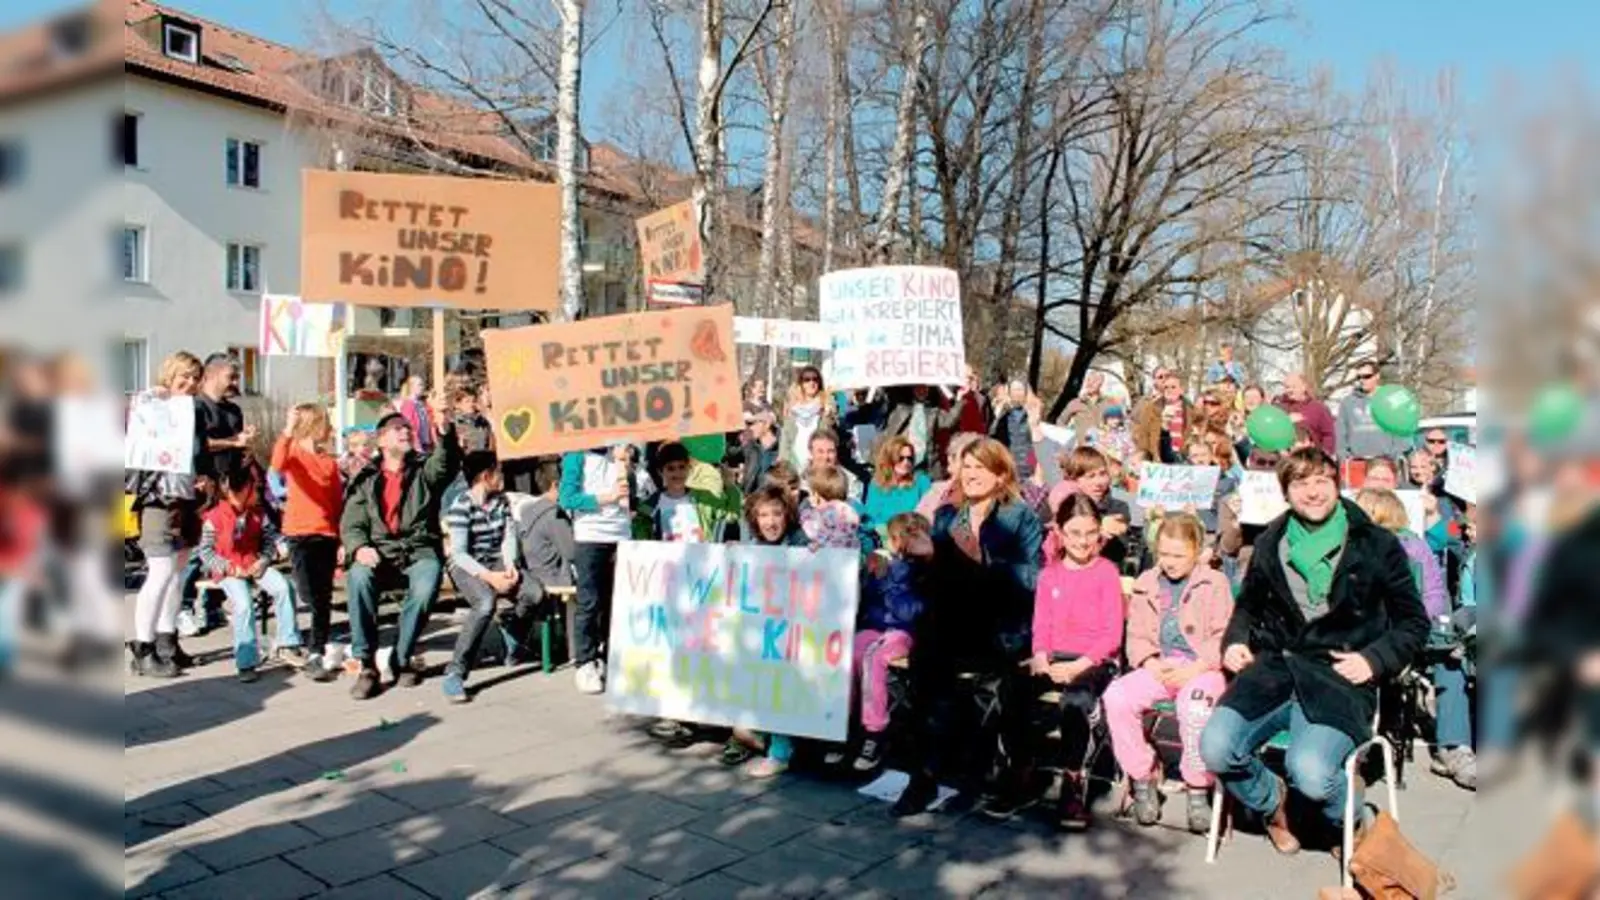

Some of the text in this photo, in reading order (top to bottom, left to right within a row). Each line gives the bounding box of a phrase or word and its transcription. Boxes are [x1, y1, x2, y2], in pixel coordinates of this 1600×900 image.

[338, 190, 469, 228] RETTET
[398, 228, 494, 257] UNSER
[899, 271, 957, 298] KINO
[900, 322, 956, 347] BIMA
[541, 337, 663, 371] RETTET
[865, 348, 962, 378] REGIERT
[601, 360, 693, 389] UNSER
